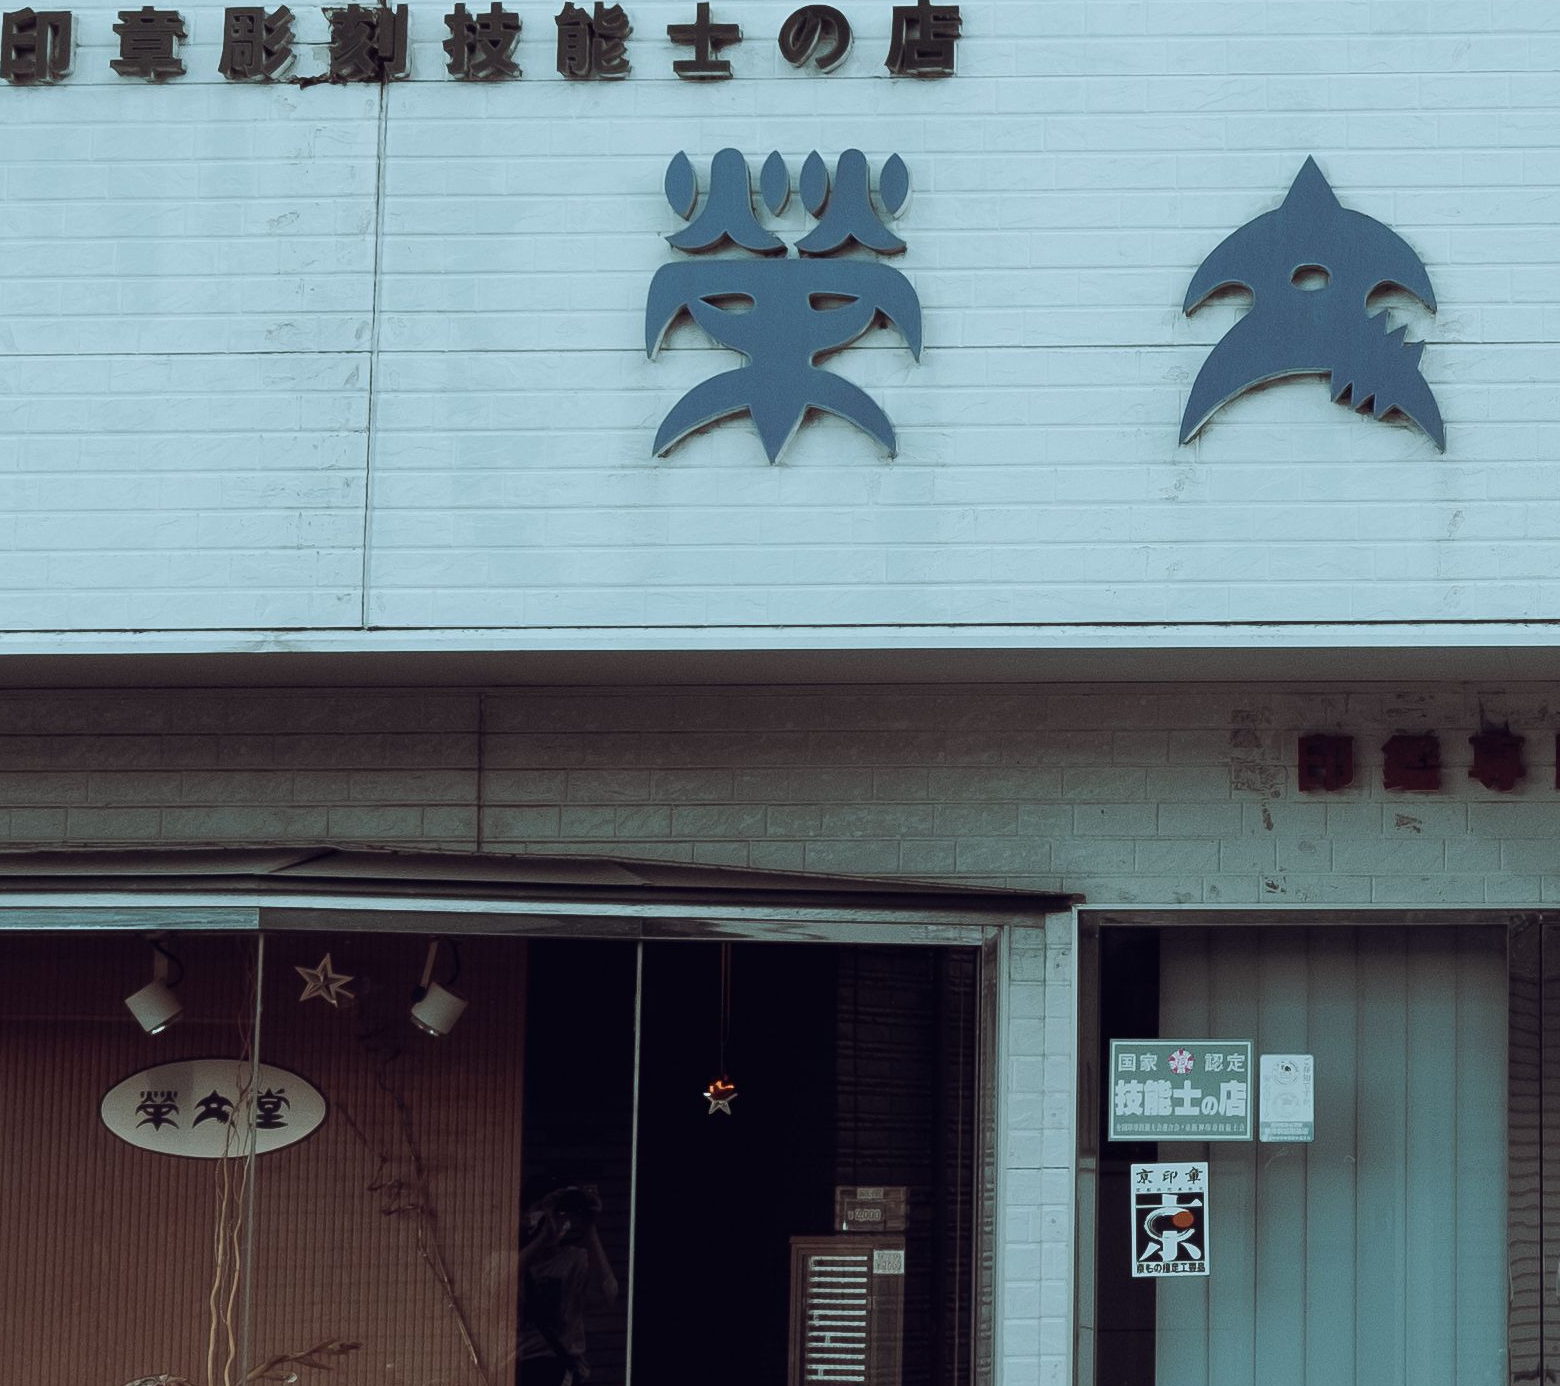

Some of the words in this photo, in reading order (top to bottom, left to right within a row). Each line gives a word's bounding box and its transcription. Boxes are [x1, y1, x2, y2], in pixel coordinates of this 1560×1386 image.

[1118, 1053, 1158, 1072] 国家
[1205, 1053, 1246, 1072] 認定
[1115, 1080, 1247, 1117] 技能士の店
